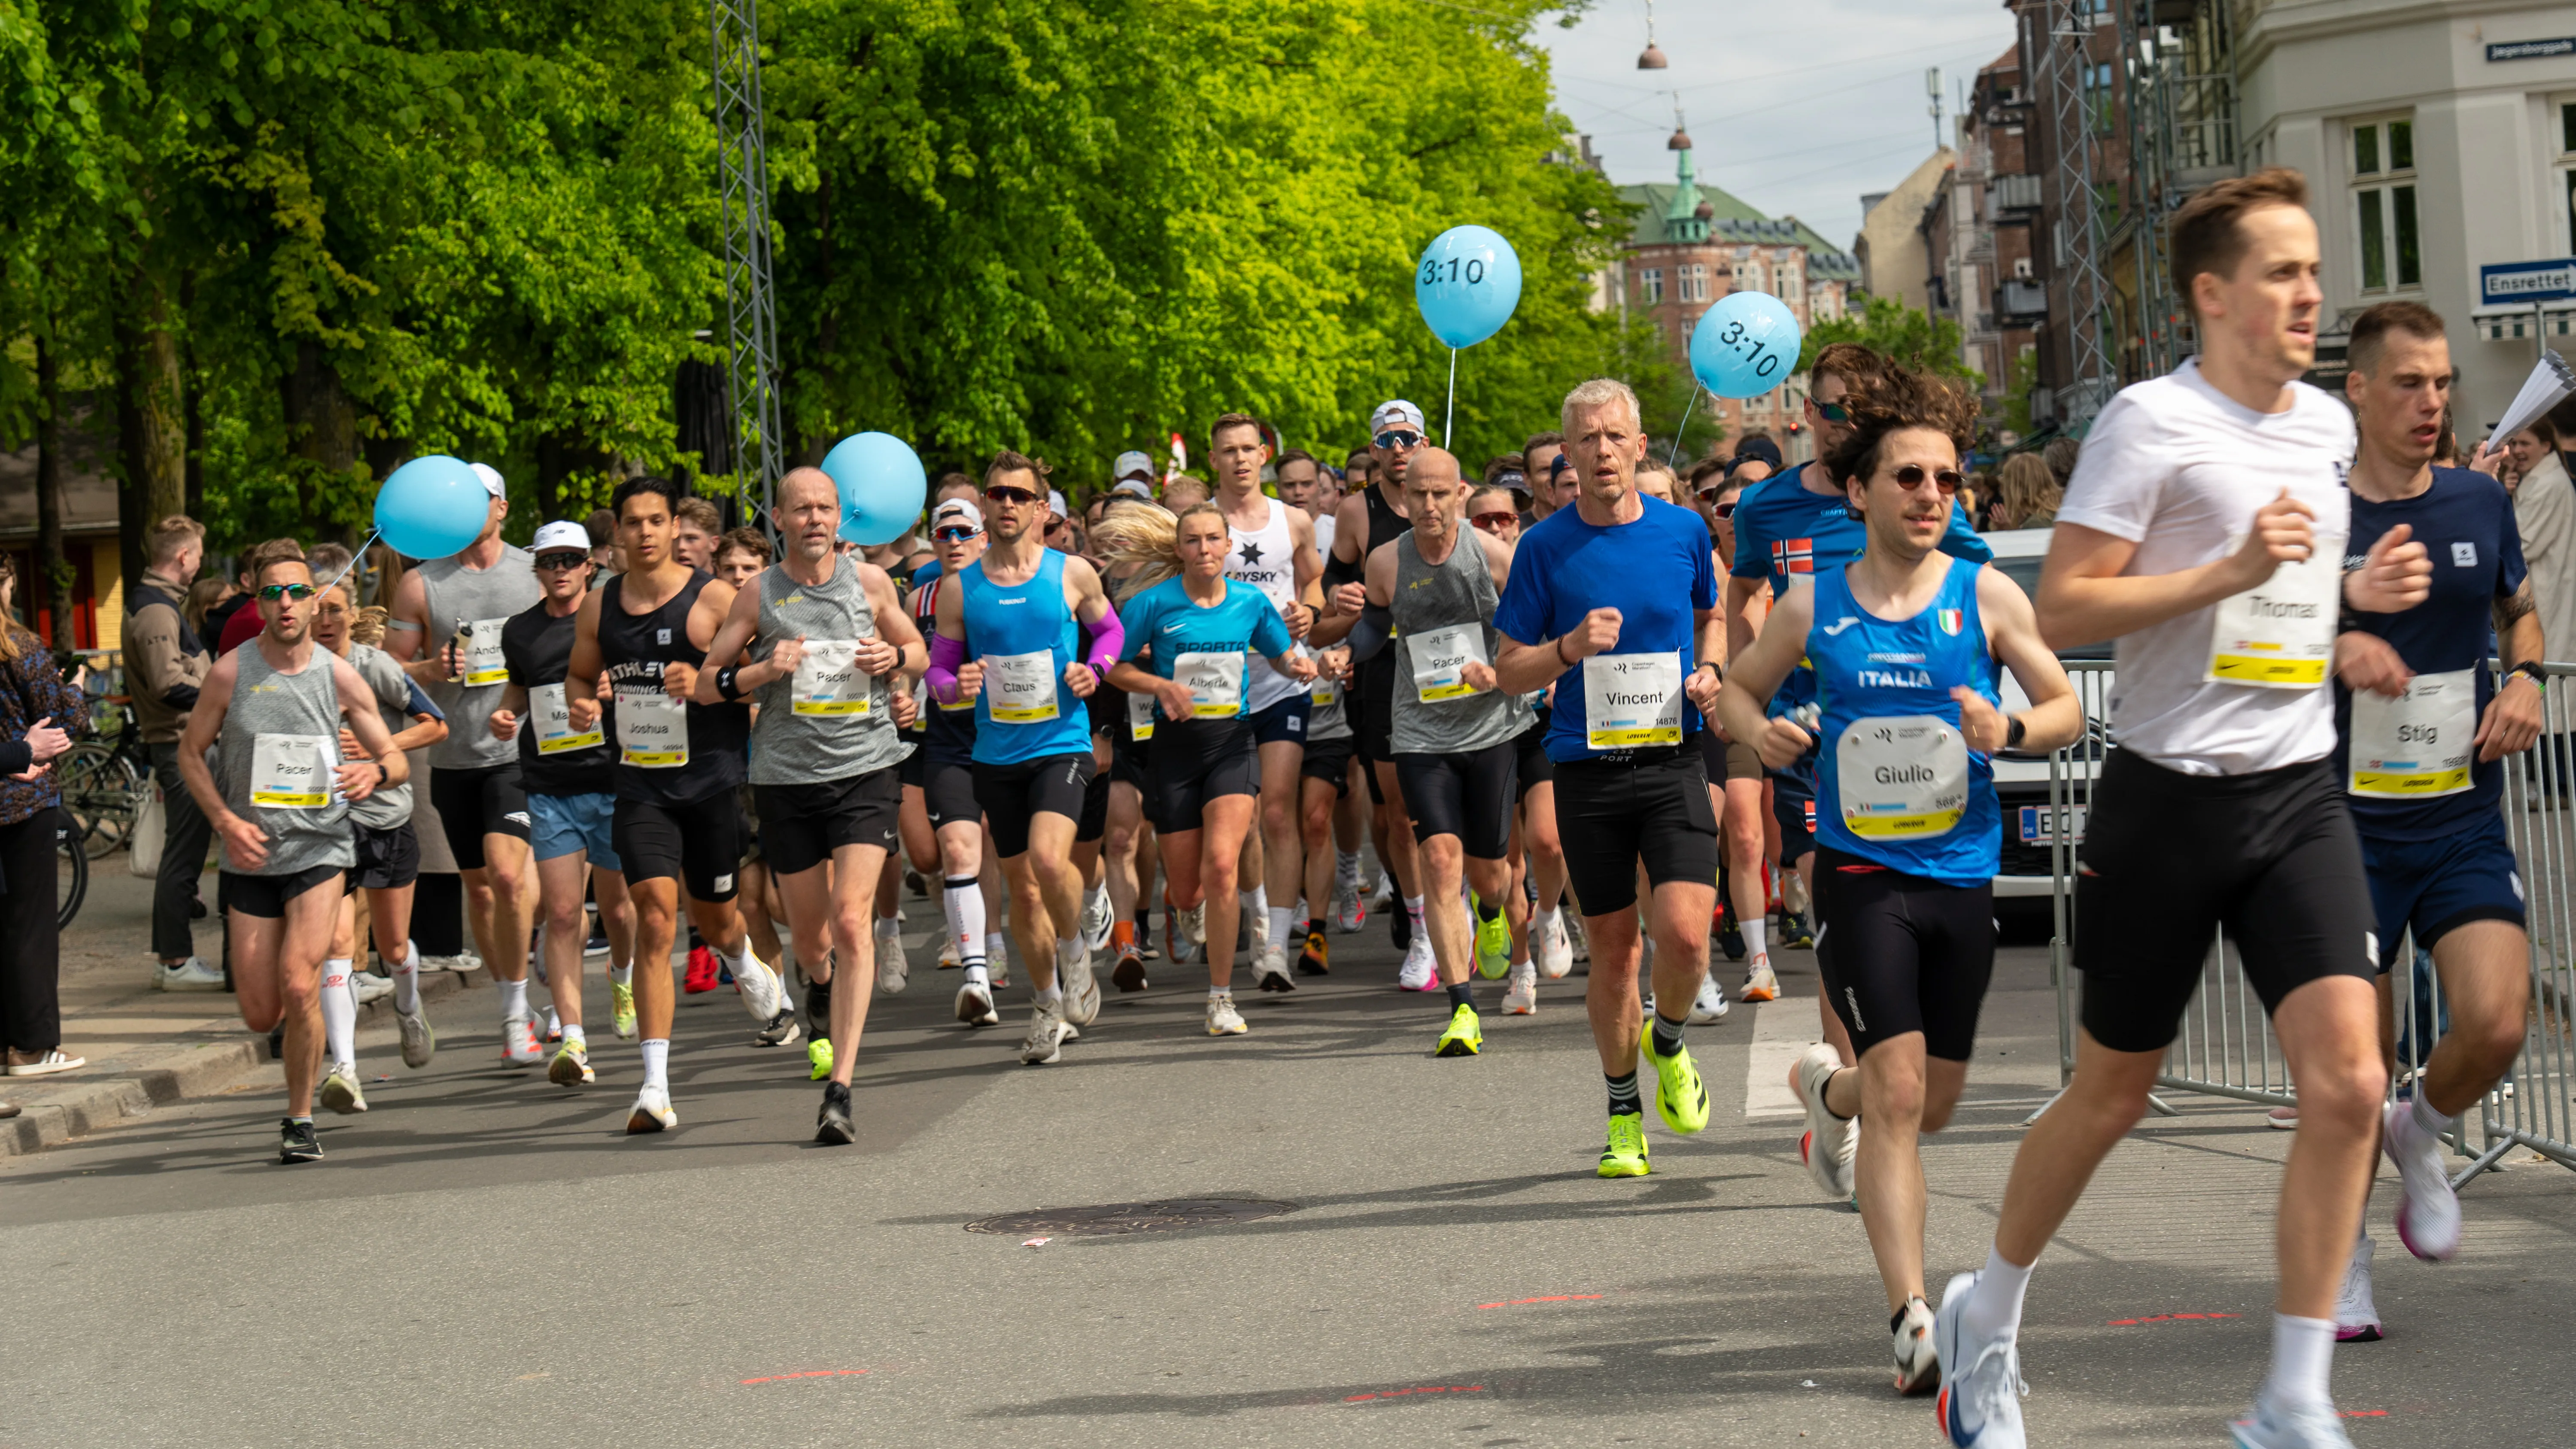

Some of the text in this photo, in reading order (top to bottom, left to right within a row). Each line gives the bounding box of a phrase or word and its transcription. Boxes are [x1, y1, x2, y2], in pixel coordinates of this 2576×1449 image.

[1422, 257, 1483, 285] 3:10
[2490, 272, 2570, 292] Ensrettet
[1721, 321, 1778, 377] 3:10
[474, 645, 501, 656] Andr
[1175, 641, 1245, 653] SPARTA
[1433, 655, 1465, 669] Pacer
[817, 671, 852, 683] Pacer
[1858, 670, 1932, 688] ITALIA
[1002, 683, 1036, 693] Claus
[1606, 691, 1664, 705] Vincent
[629, 722, 669, 735] Joshua
[1656, 717, 1677, 726] 14876
[2397, 724, 2438, 745] Stig
[276, 763, 313, 775] Pacer
[1874, 765, 1935, 785] Giulio
